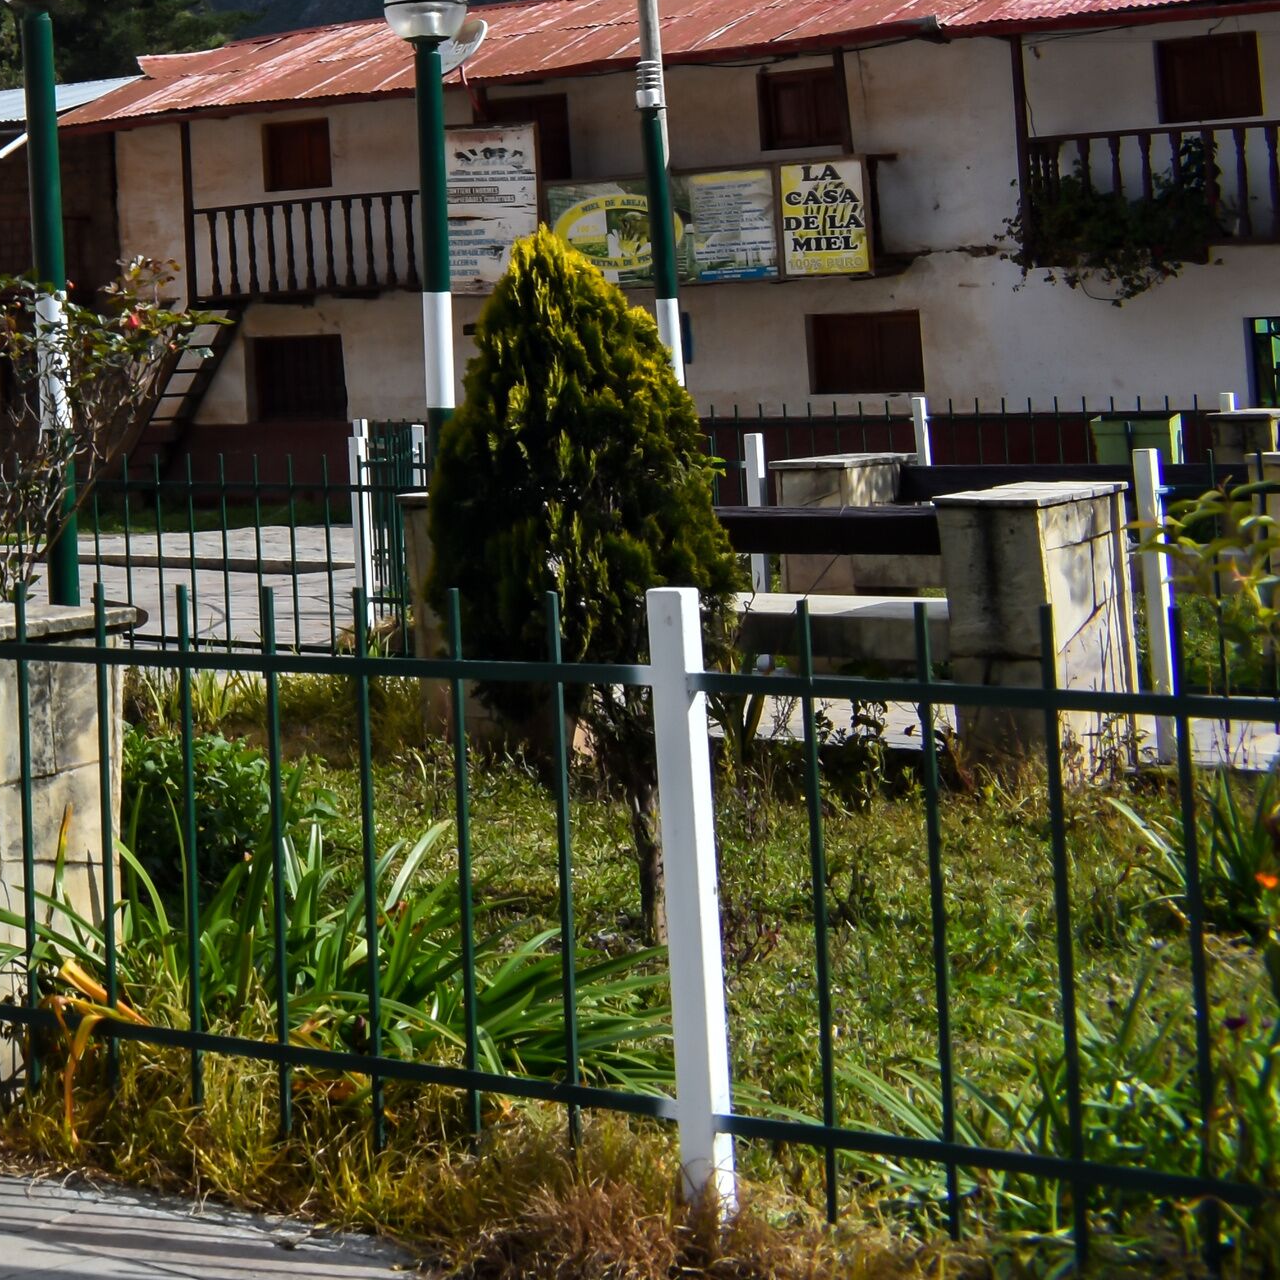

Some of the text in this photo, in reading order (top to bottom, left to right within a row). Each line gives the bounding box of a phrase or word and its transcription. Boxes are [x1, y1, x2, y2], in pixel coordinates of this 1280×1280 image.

[801, 164, 841, 182] LA
[785, 188, 860, 206] CASA
[784, 215, 820, 231] DE
[826, 214, 865, 229] LA
[791, 235, 858, 252] MIEL
[788, 255, 865, 270] 100% PURO
